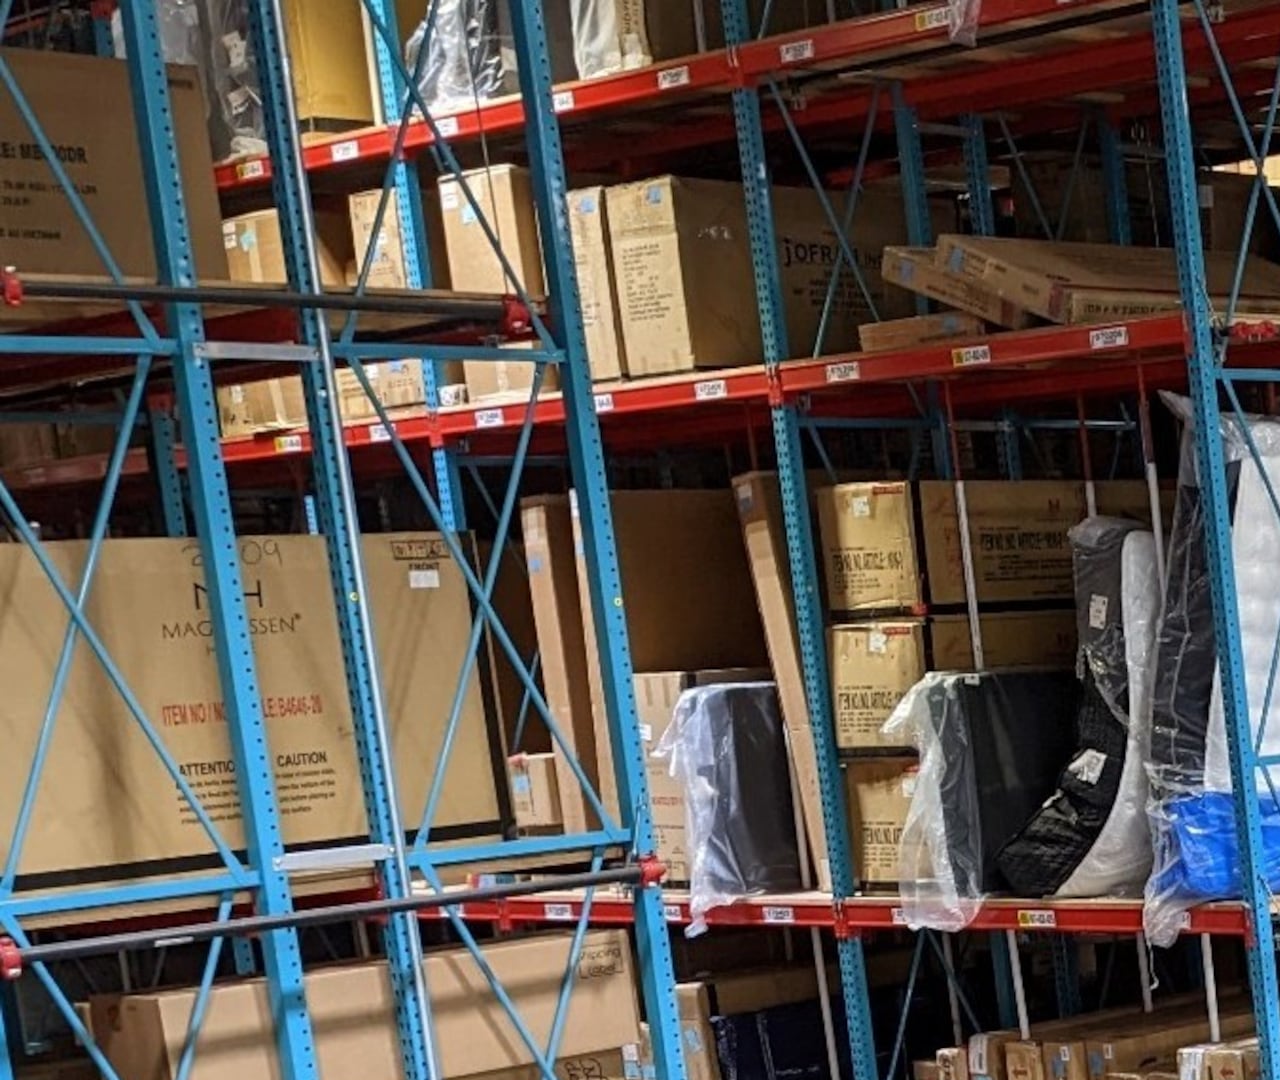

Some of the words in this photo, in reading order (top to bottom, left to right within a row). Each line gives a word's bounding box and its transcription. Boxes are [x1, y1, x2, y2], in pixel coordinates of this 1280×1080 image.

[162, 615, 297, 640] MAGSSEN
[179, 759, 236, 777] ATTENTIO
[277, 751, 327, 768] CAUTION
